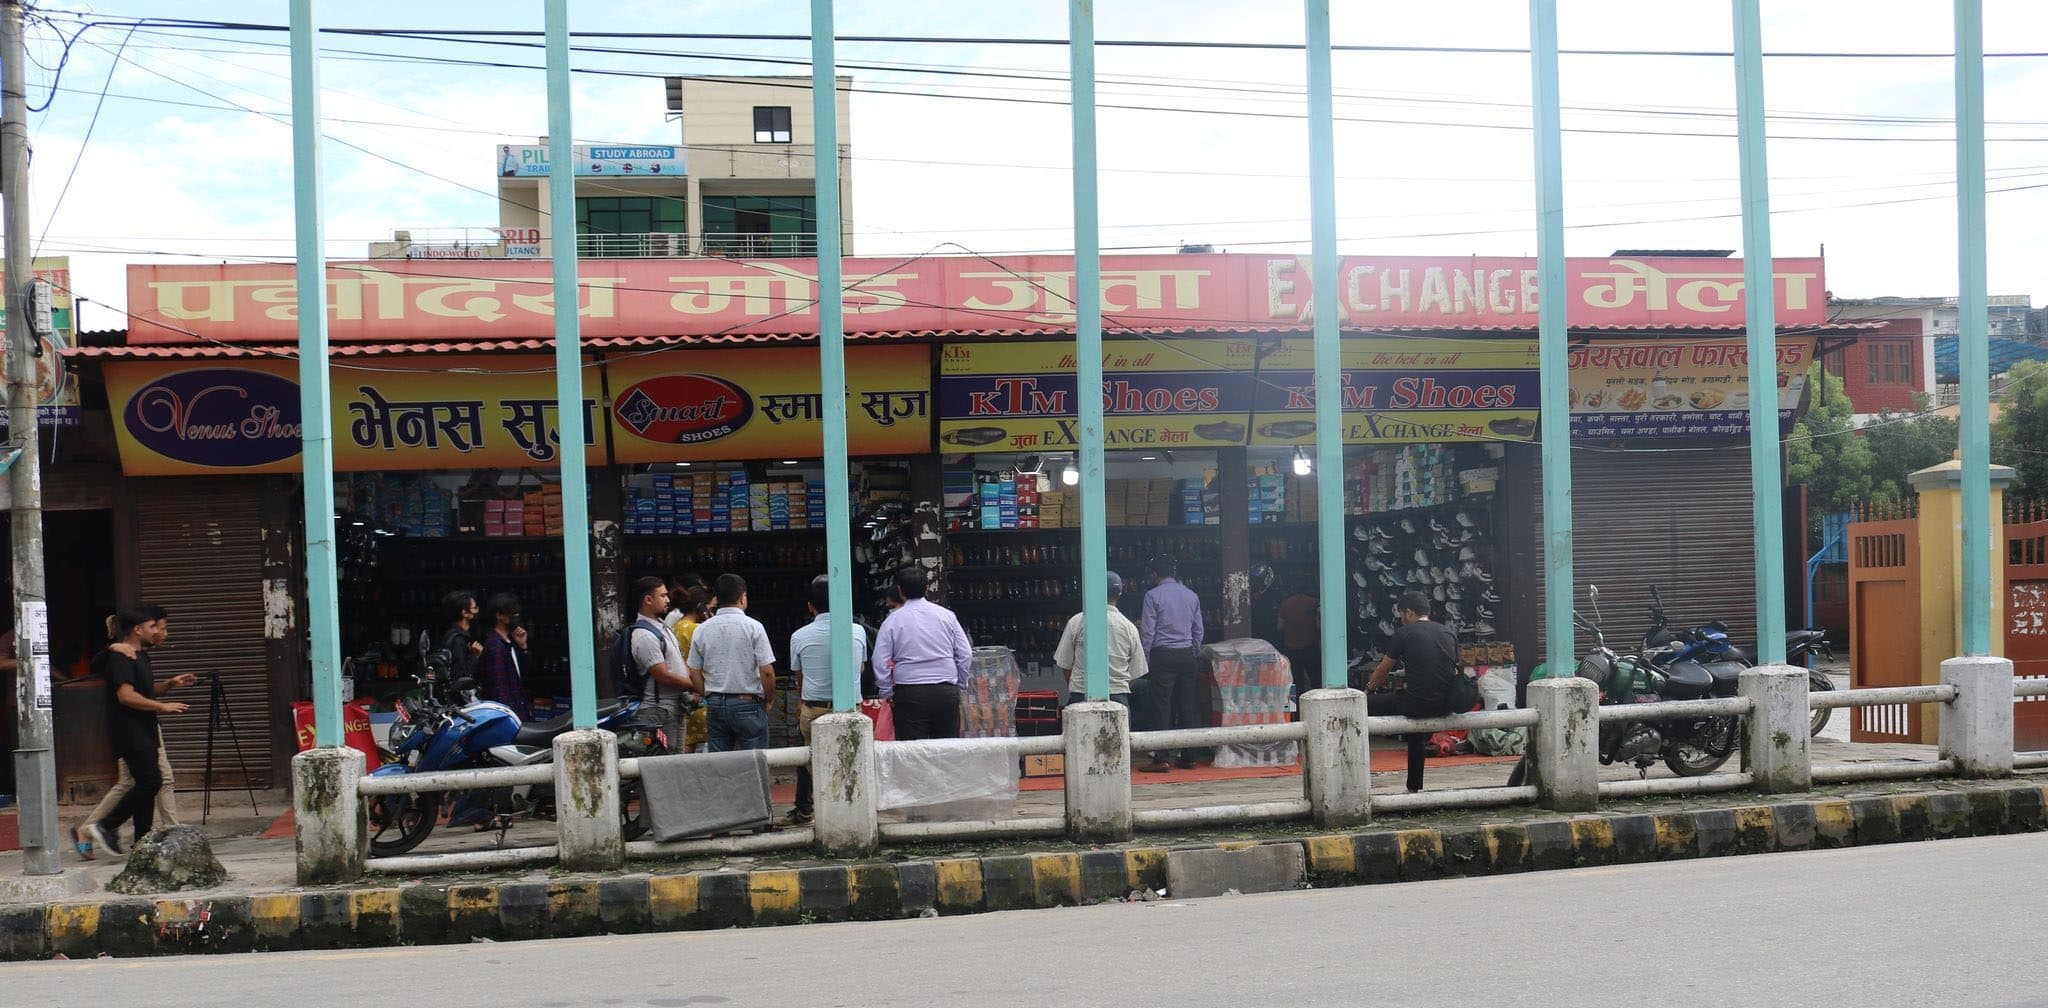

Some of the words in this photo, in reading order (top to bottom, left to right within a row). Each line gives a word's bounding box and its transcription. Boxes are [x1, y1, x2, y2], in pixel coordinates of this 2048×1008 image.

[594, 149, 626, 159] STUDY
[629, 149, 671, 159] ABROAD
[502, 229, 540, 245] RLD
[668, 262, 918, 316] मोड
[960, 270, 1211, 324] जुता
[1581, 259, 1817, 313] मेला
[1114, 354, 1128, 367] in
[1132, 352, 1154, 367] all
[628, 387, 737, 424] Smart
[861, 390, 930, 428] सुज
[968, 377, 1068, 416] KTM
[1284, 372, 1378, 409] KM
[1389, 377, 1517, 409] Shoes
[136, 386, 248, 441] Venus
[240, 404, 304, 438] Shoe
[348, 385, 486, 453] भेनस
[1350, 412, 1454, 439] EXCHANGE
[681, 425, 732, 443] SHOES
[1010, 432, 1038, 449] जुता
[1043, 420, 1156, 446] EXANGE
[1160, 428, 1189, 443] मेला
